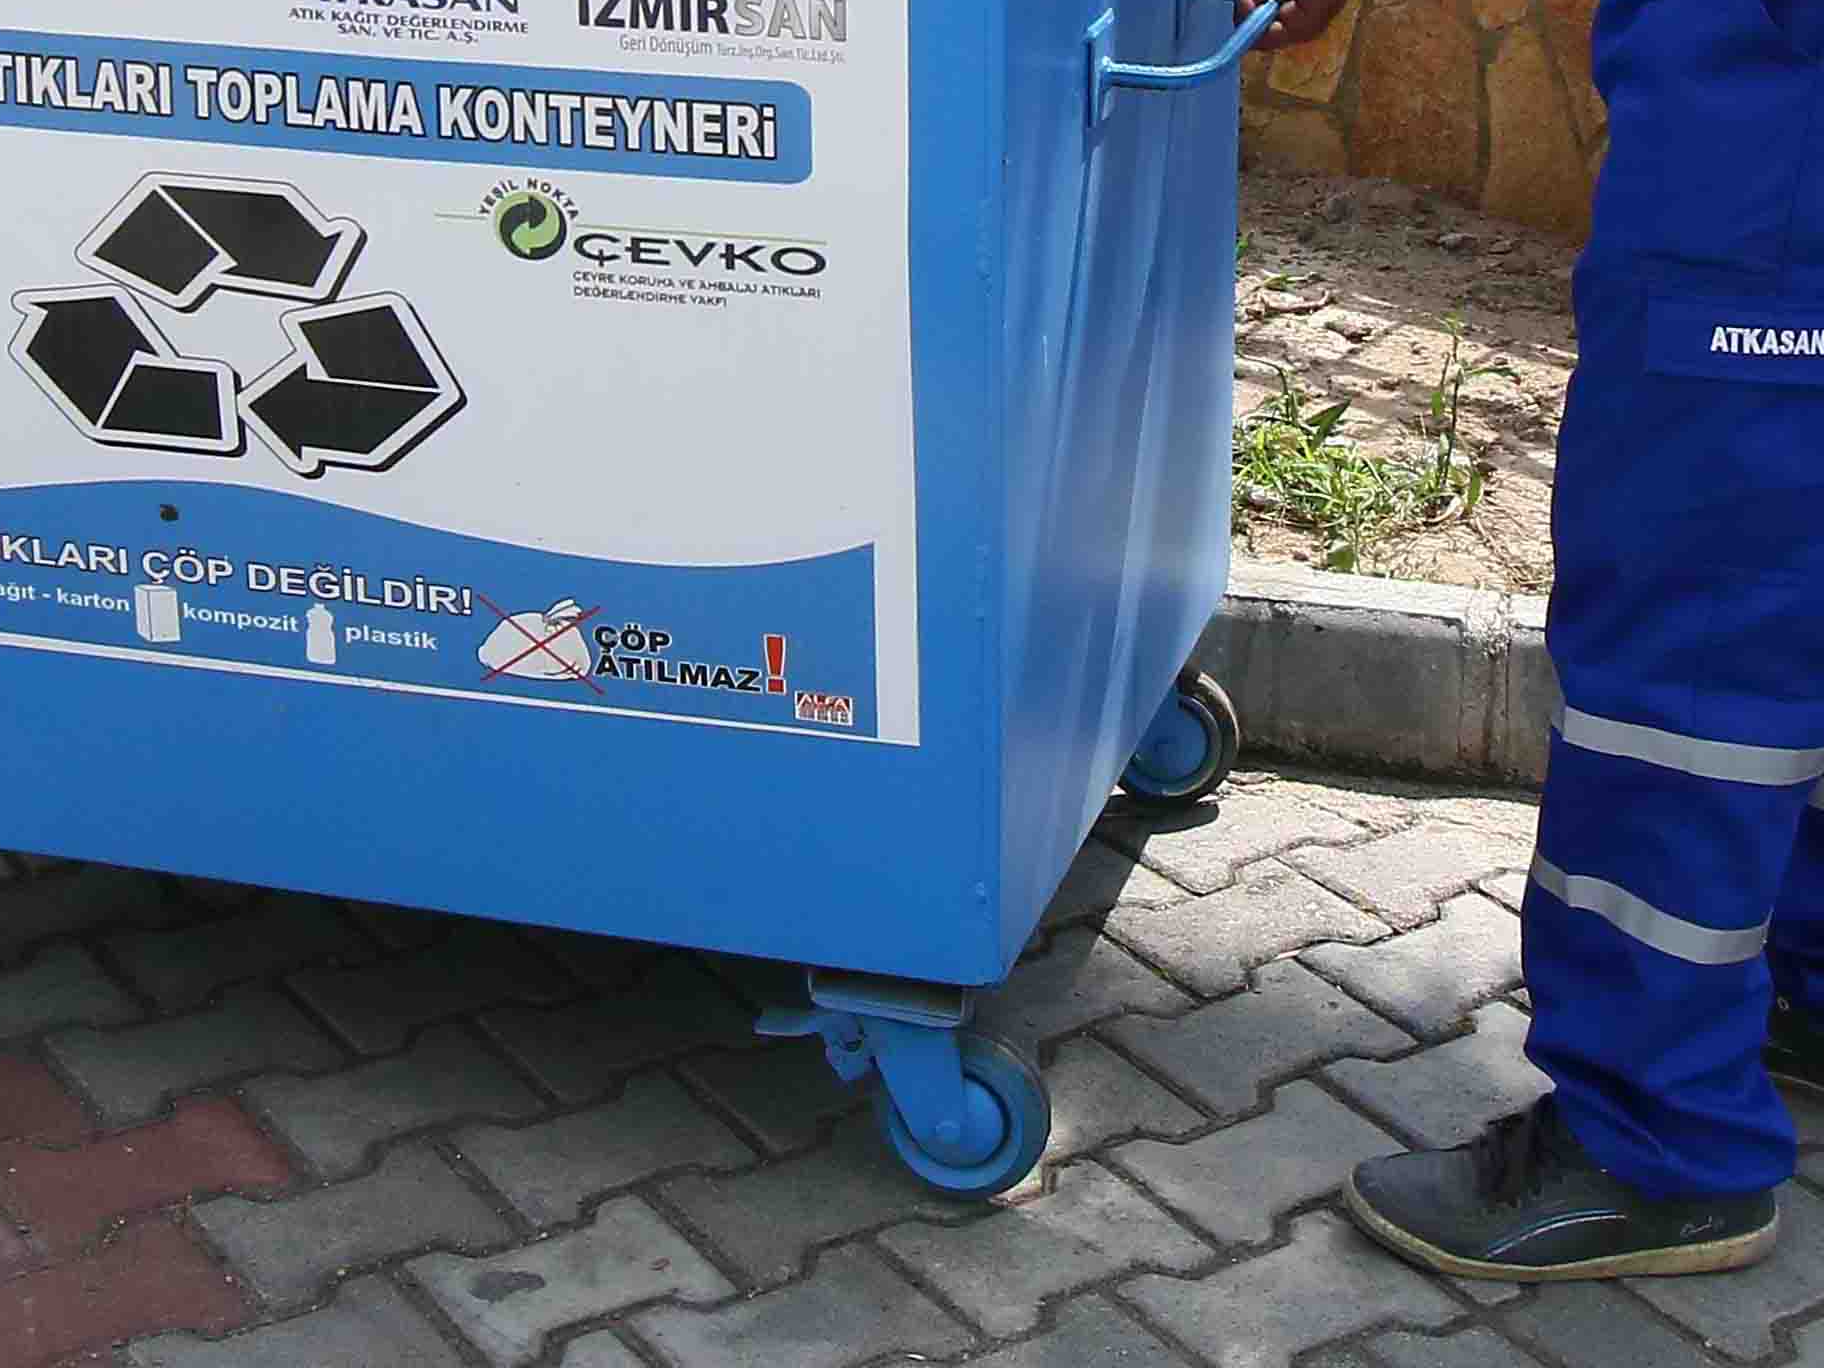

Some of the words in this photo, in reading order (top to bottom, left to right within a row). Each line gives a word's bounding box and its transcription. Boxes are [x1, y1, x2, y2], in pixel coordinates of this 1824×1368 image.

[289, 7, 326, 22] ATIK
[383, 26, 406, 39] VE
[619, 34, 647, 53] Geri
[184, 64, 425, 137] TOPLAMA
[527, 177, 580, 220] NOKTA
[574, 233, 827, 276] ÇEVKO
[141, 548, 234, 586] ÇÖP
[246, 561, 473, 617] DEĞİLDİR!
[56, 587, 130, 612] karton
[183, 602, 301, 632] kompozit
[345, 623, 439, 651] plastik
[594, 623, 672, 654] ÇÖP
